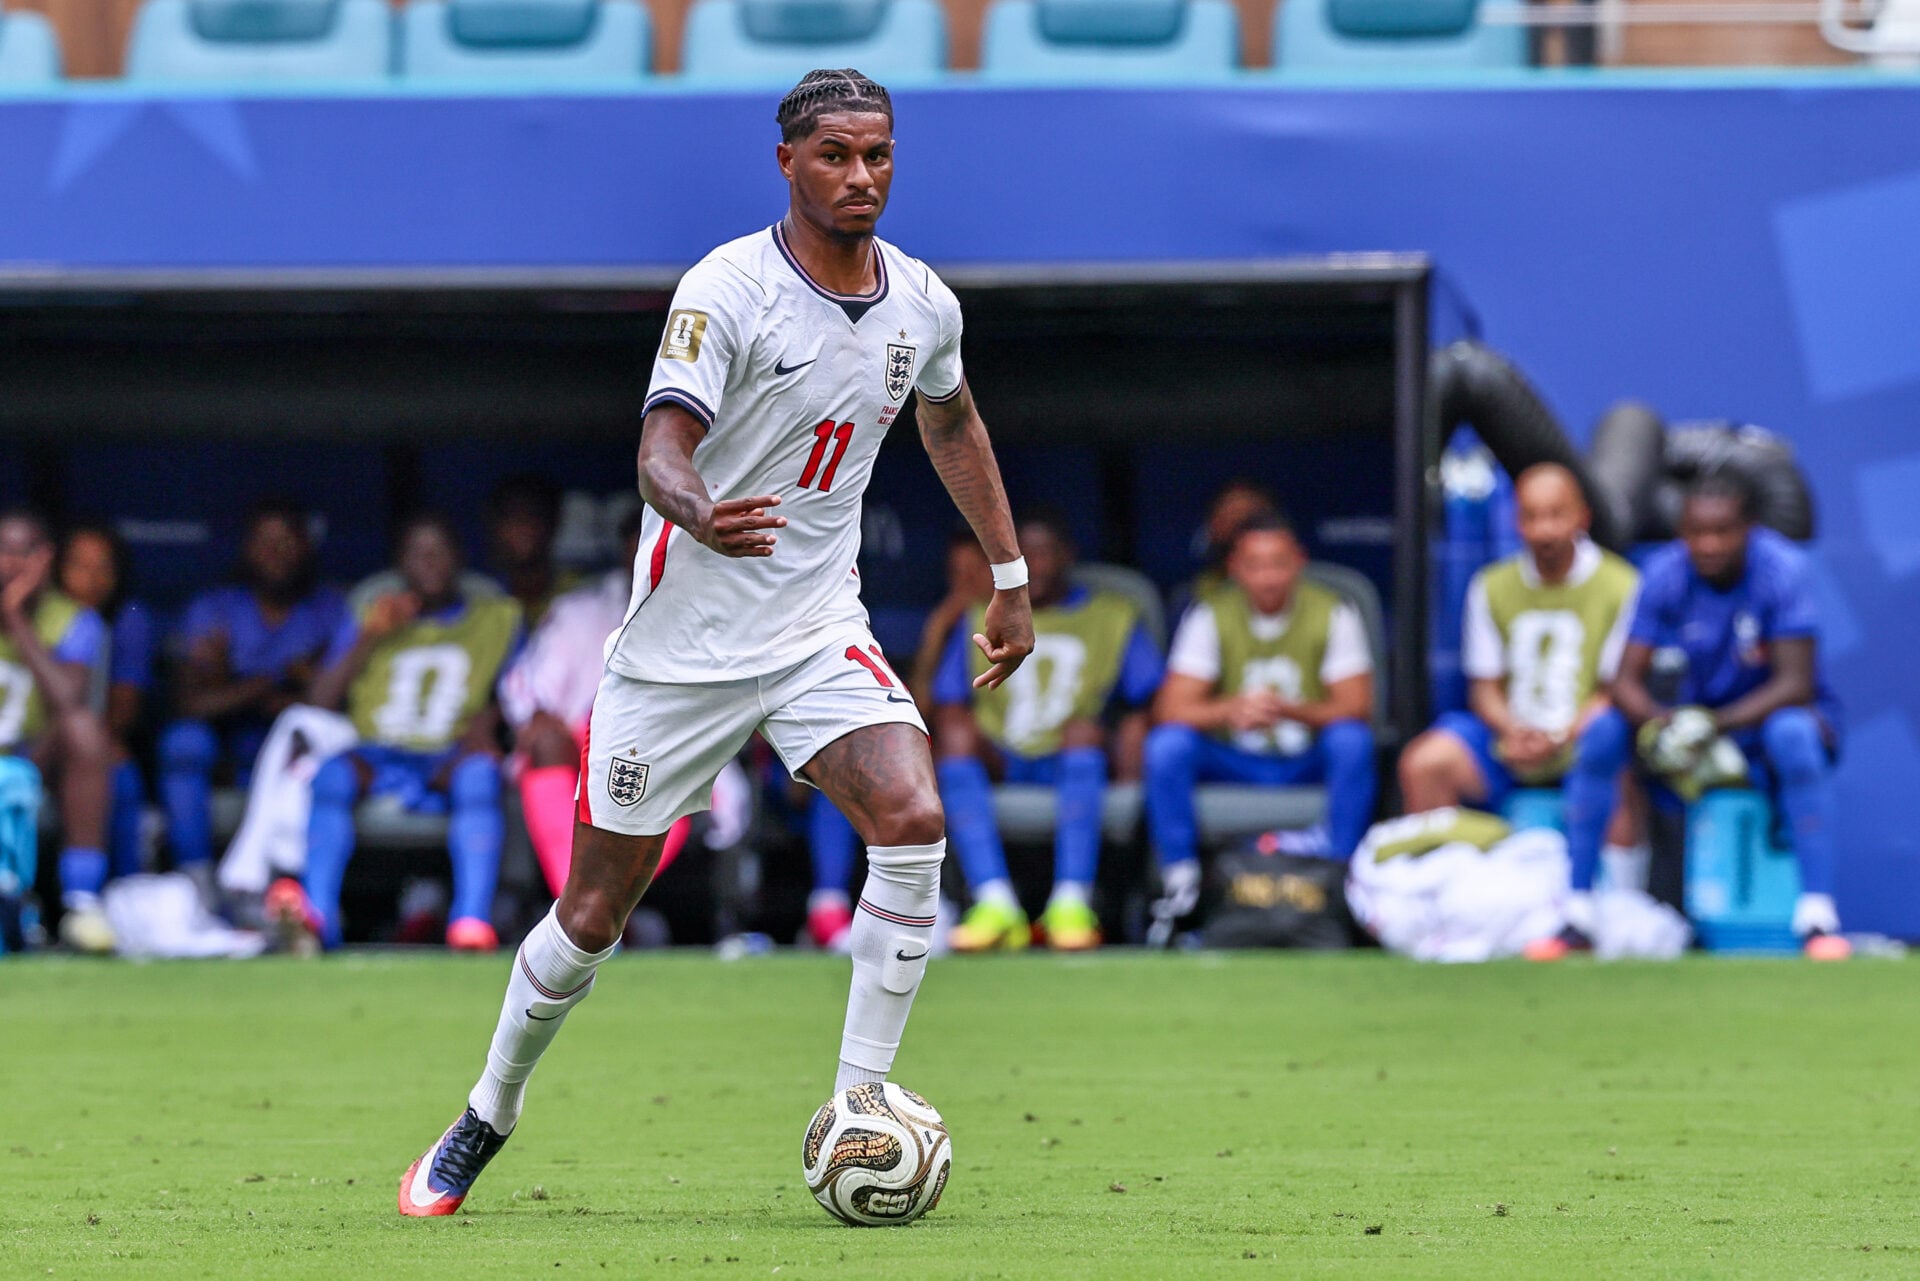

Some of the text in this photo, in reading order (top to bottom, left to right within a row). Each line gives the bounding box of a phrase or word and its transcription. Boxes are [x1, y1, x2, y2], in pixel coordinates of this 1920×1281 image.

[881, 405, 899, 415] FRANC
[797, 420, 855, 492] 11
[866, 1140, 893, 1157] NEW
